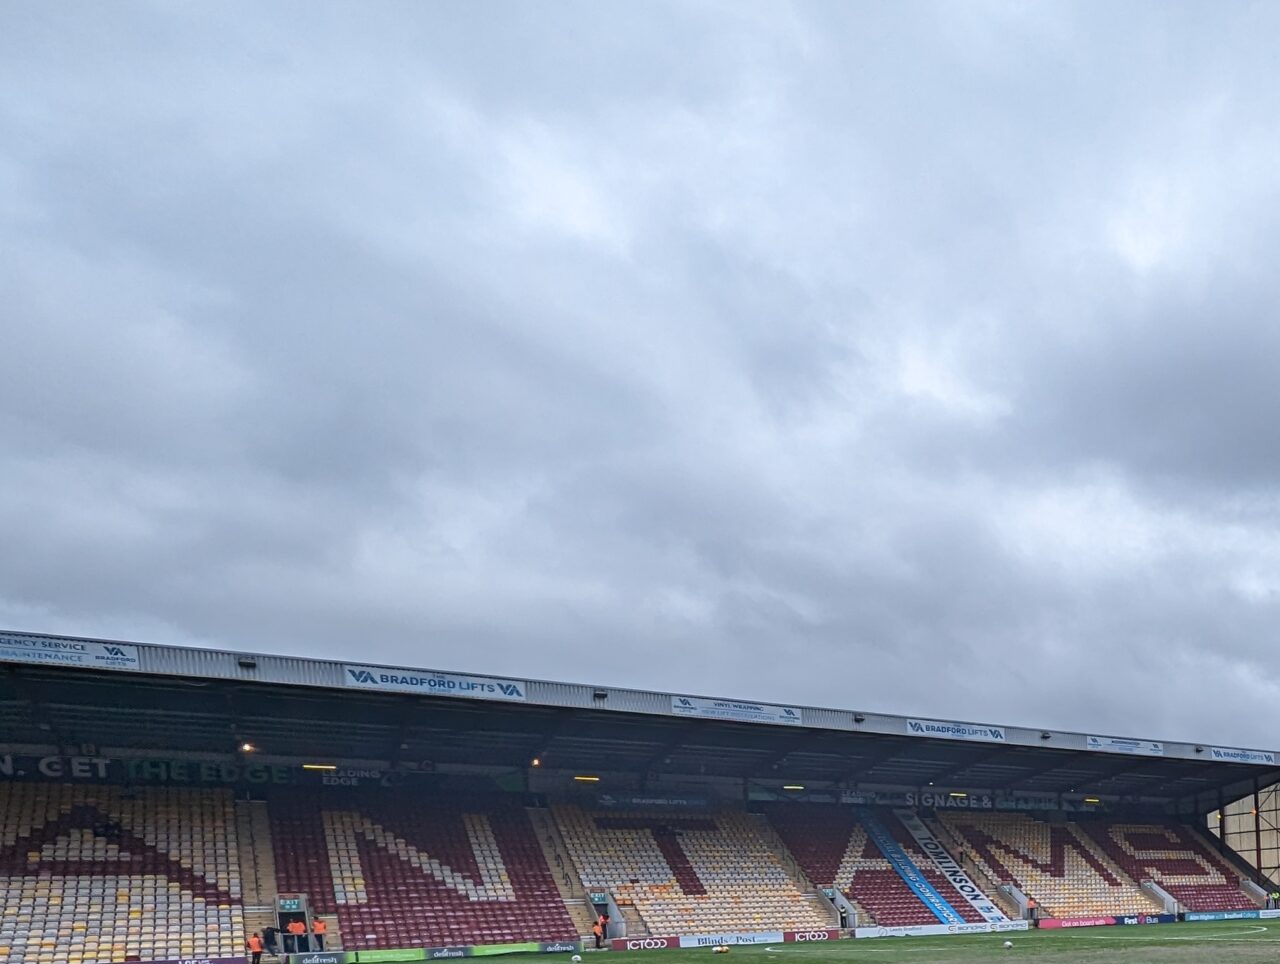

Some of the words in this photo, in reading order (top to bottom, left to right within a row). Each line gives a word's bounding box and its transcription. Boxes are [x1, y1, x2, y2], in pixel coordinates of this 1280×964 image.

[41, 640, 87, 652] SERVICE
[95, 655, 136, 663] BRADFORD
[379, 673, 456, 690] BRADFORD
[458, 681, 496, 693] LIFTS
[732, 703, 764, 712] WRAPPING
[925, 724, 967, 735] BRADFORD
[967, 729, 988, 737] LIFTS
[38, 755, 111, 779] GET
[124, 757, 187, 782] THE
[322, 769, 381, 779] LEADING
[322, 776, 359, 786] EDGE
[632, 797, 667, 806] BRADFORD
[906, 793, 978, 809] SIGNAGE
[983, 795, 993, 809] &
[918, 836, 985, 901] TOMLINSON
[280, 898, 299, 906] EXIT
[1124, 917, 1138, 925] First
[698, 936, 728, 945] Blinds
[735, 935, 757, 943] Post
